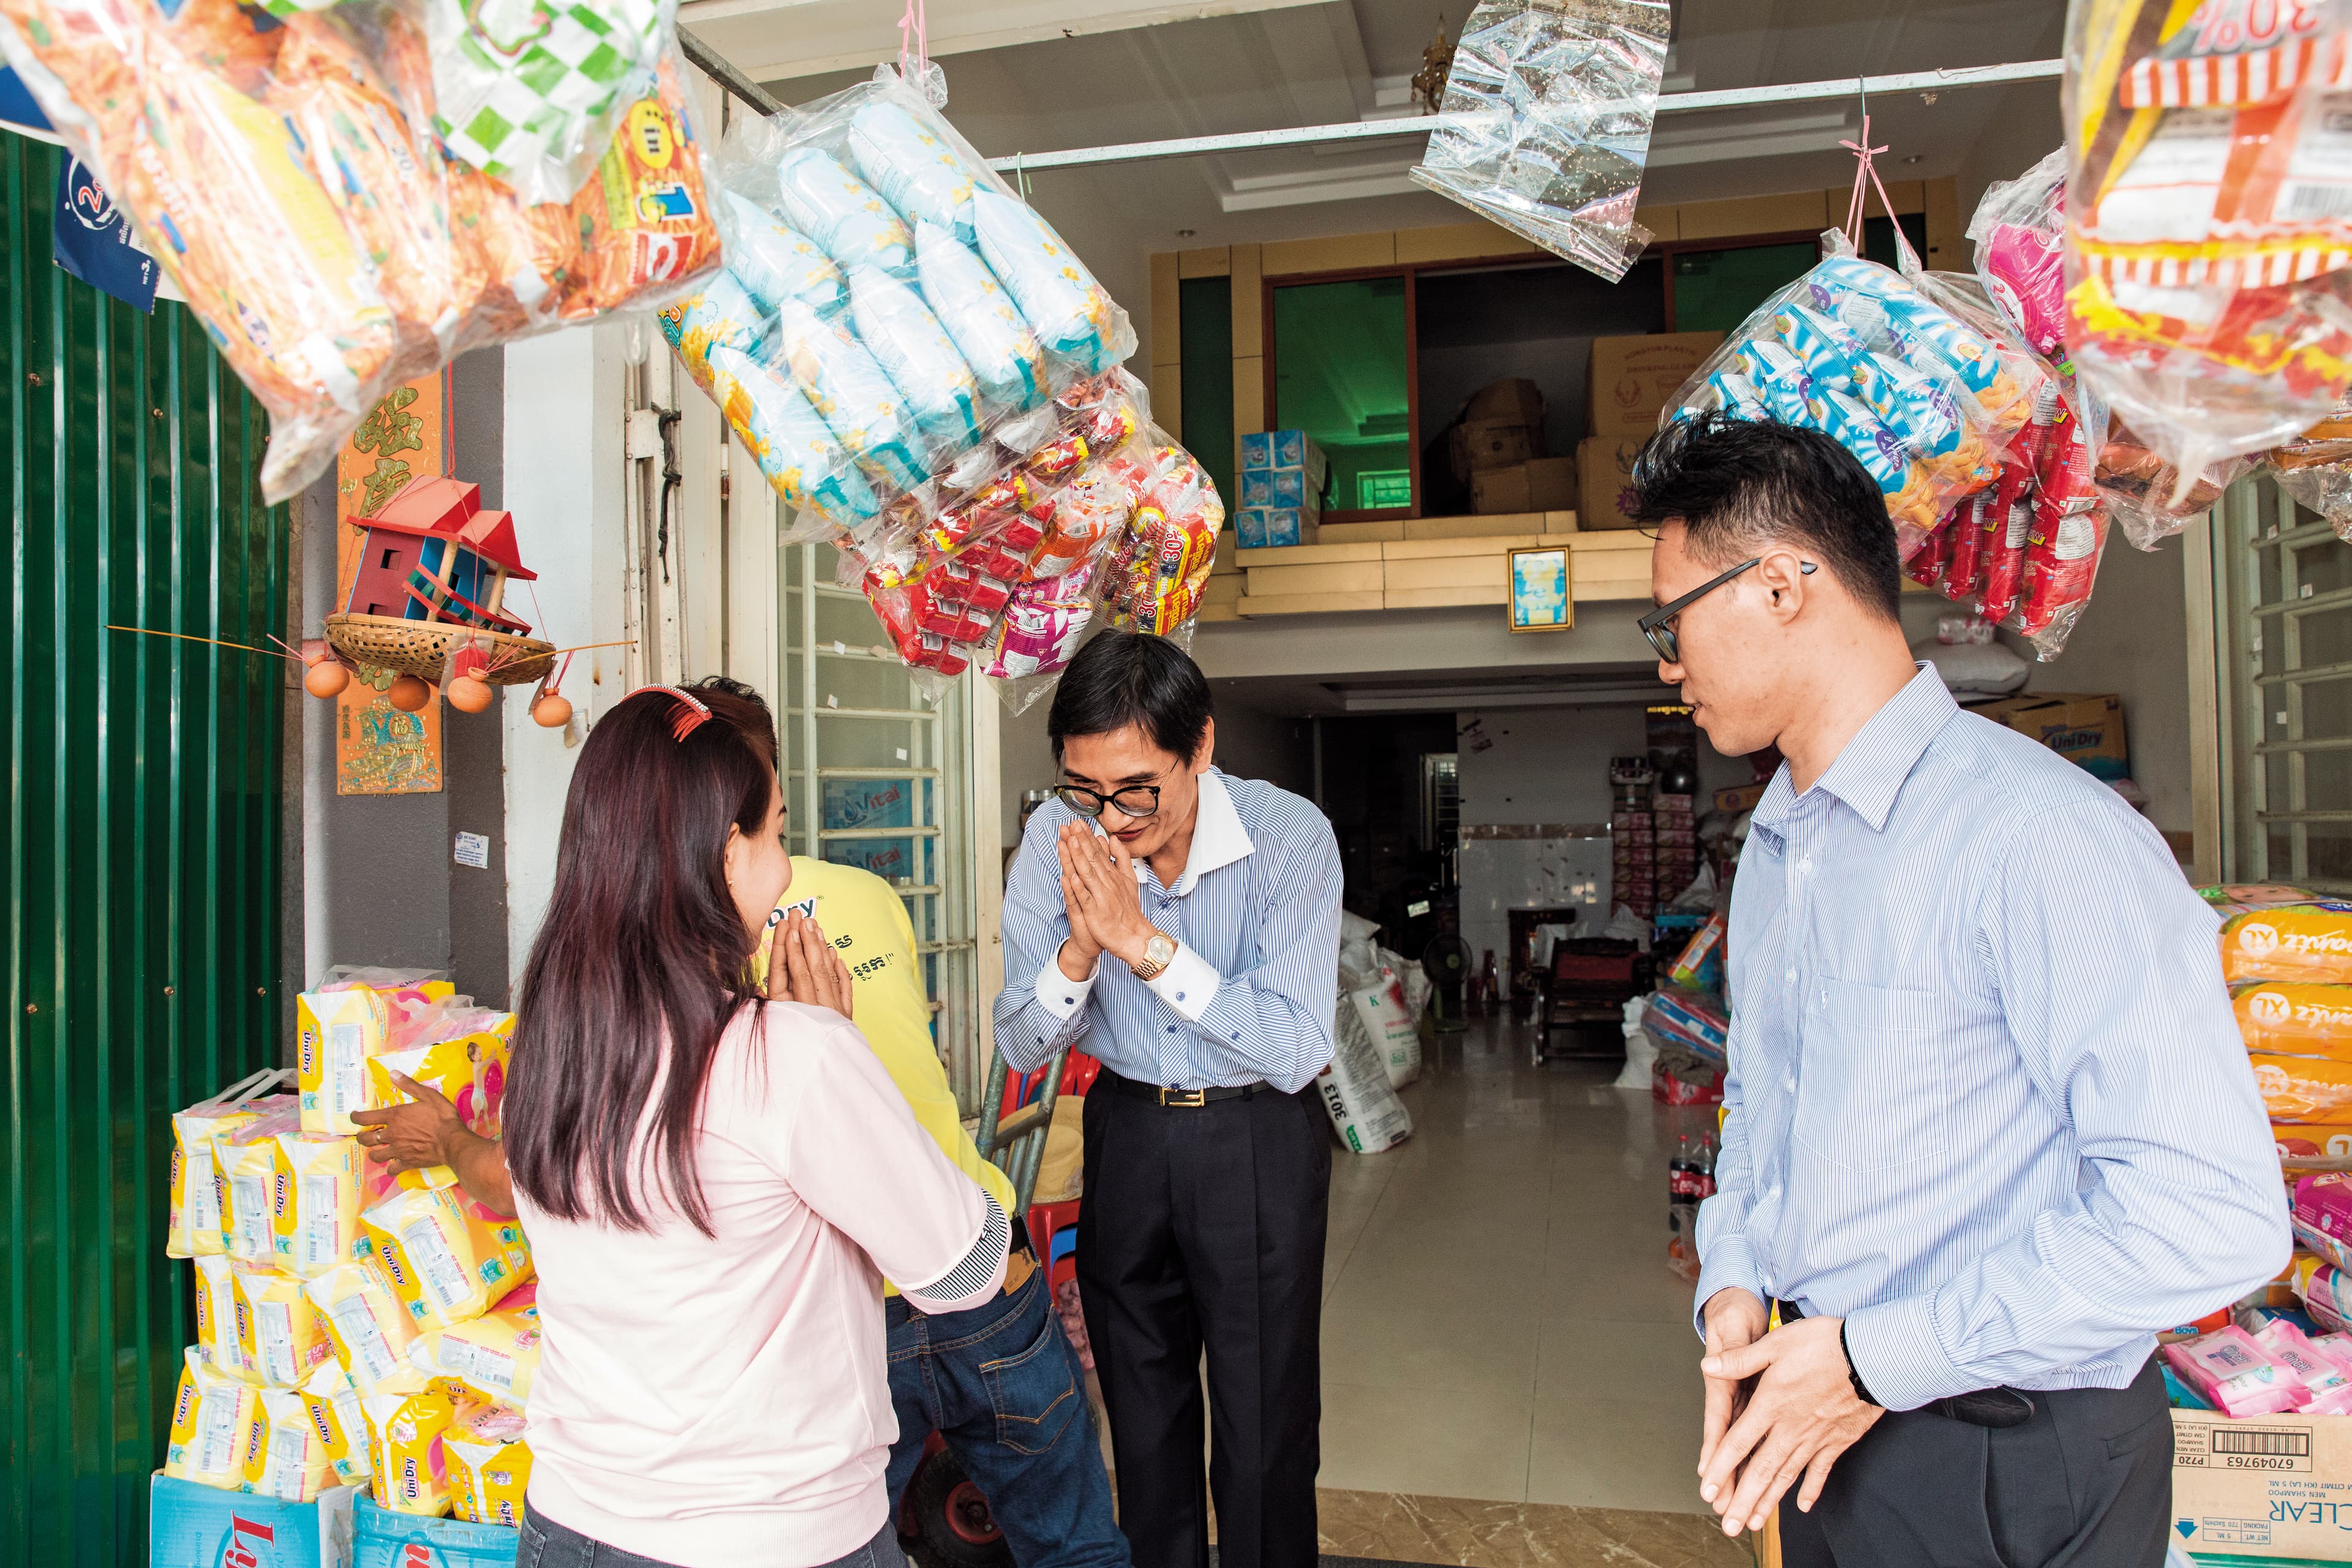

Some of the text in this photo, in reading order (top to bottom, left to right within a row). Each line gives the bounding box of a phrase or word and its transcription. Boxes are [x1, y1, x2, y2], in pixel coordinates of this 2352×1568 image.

[1163, 529, 1184, 562] 30%
[2244, 930, 2274, 949] XL
[1324, 1084, 1346, 1120] 3013
[2179, 1456, 2204, 1465] P720
[2227, 1456, 2294, 1469] 67049763
[2269, 1500, 2352, 1531] CLEAR
